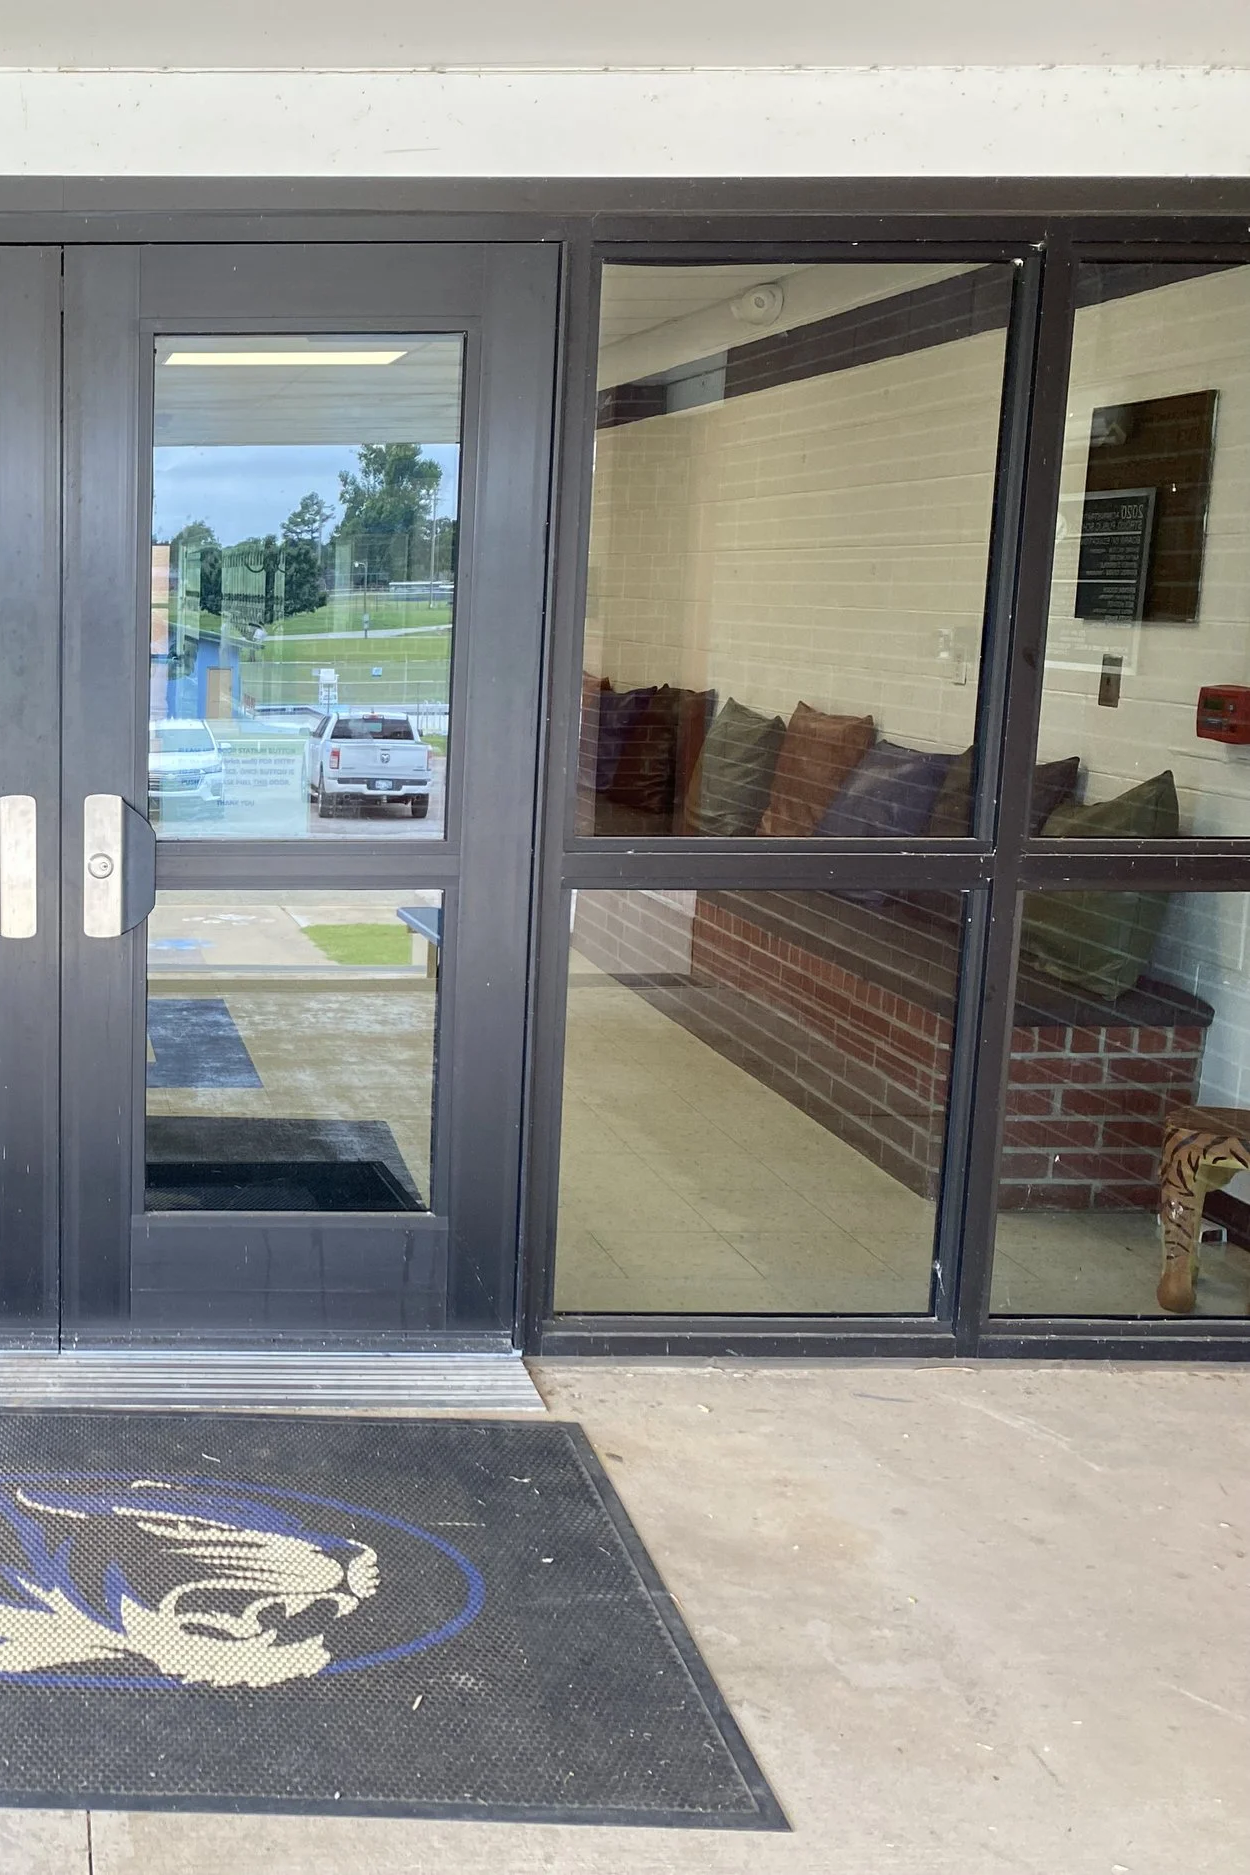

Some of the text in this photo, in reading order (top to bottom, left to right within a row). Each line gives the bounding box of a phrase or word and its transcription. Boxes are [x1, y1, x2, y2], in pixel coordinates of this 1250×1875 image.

[268, 747, 296, 755] BUTTON
[216, 799, 255, 807] THANK YOU
